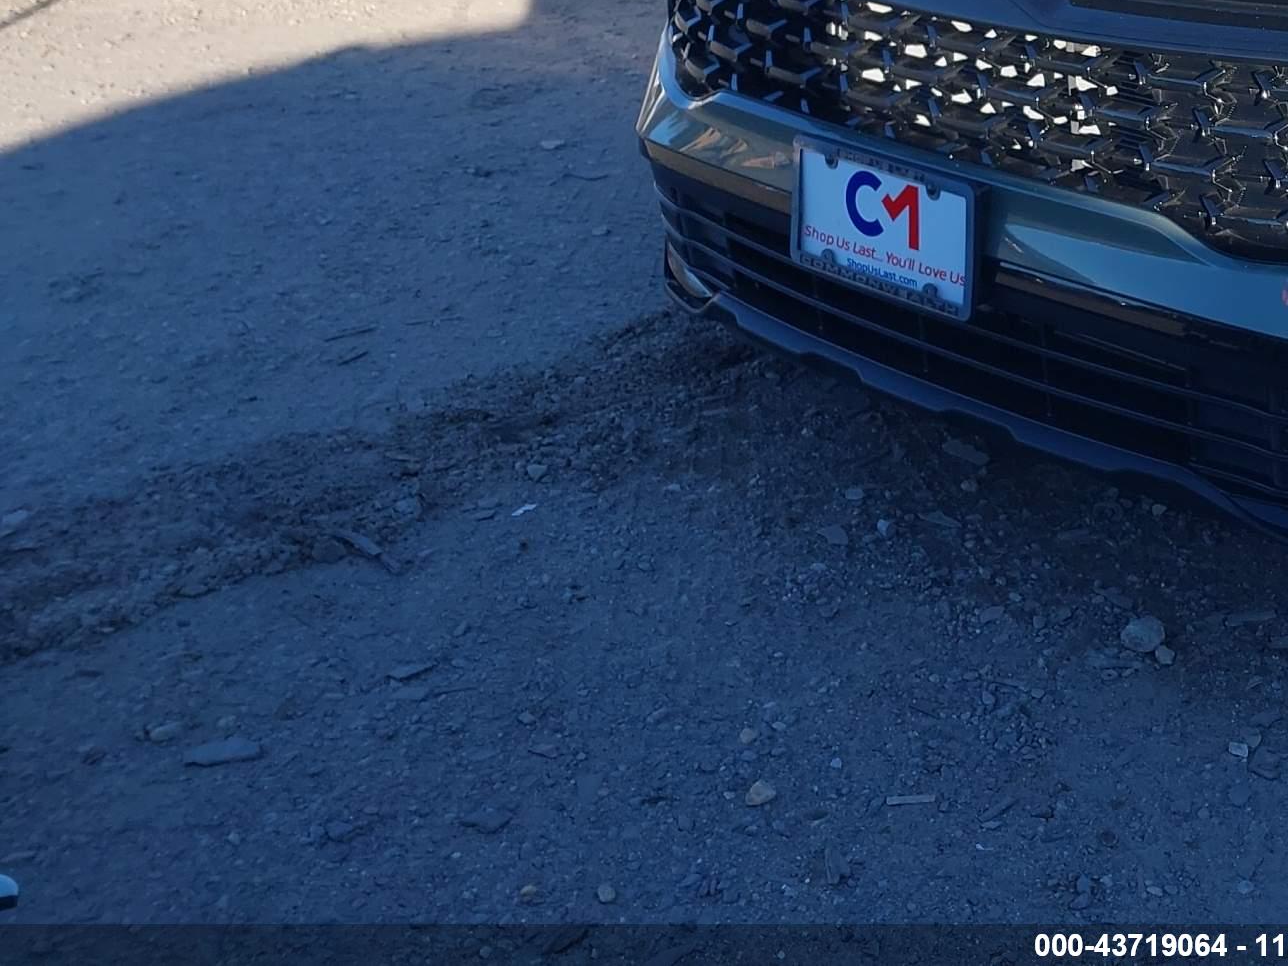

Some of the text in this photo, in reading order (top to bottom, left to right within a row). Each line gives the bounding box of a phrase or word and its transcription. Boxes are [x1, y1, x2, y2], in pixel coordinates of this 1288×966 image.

[845, 170, 920, 252] CM
[804, 225, 835, 246] Shop
[836, 238, 851, 251] Us
[886, 251, 916, 271] You'll
[918, 262, 948, 282] Love
[949, 272, 967, 287] Us
[846, 257, 919, 288] ShopUsLast.com
